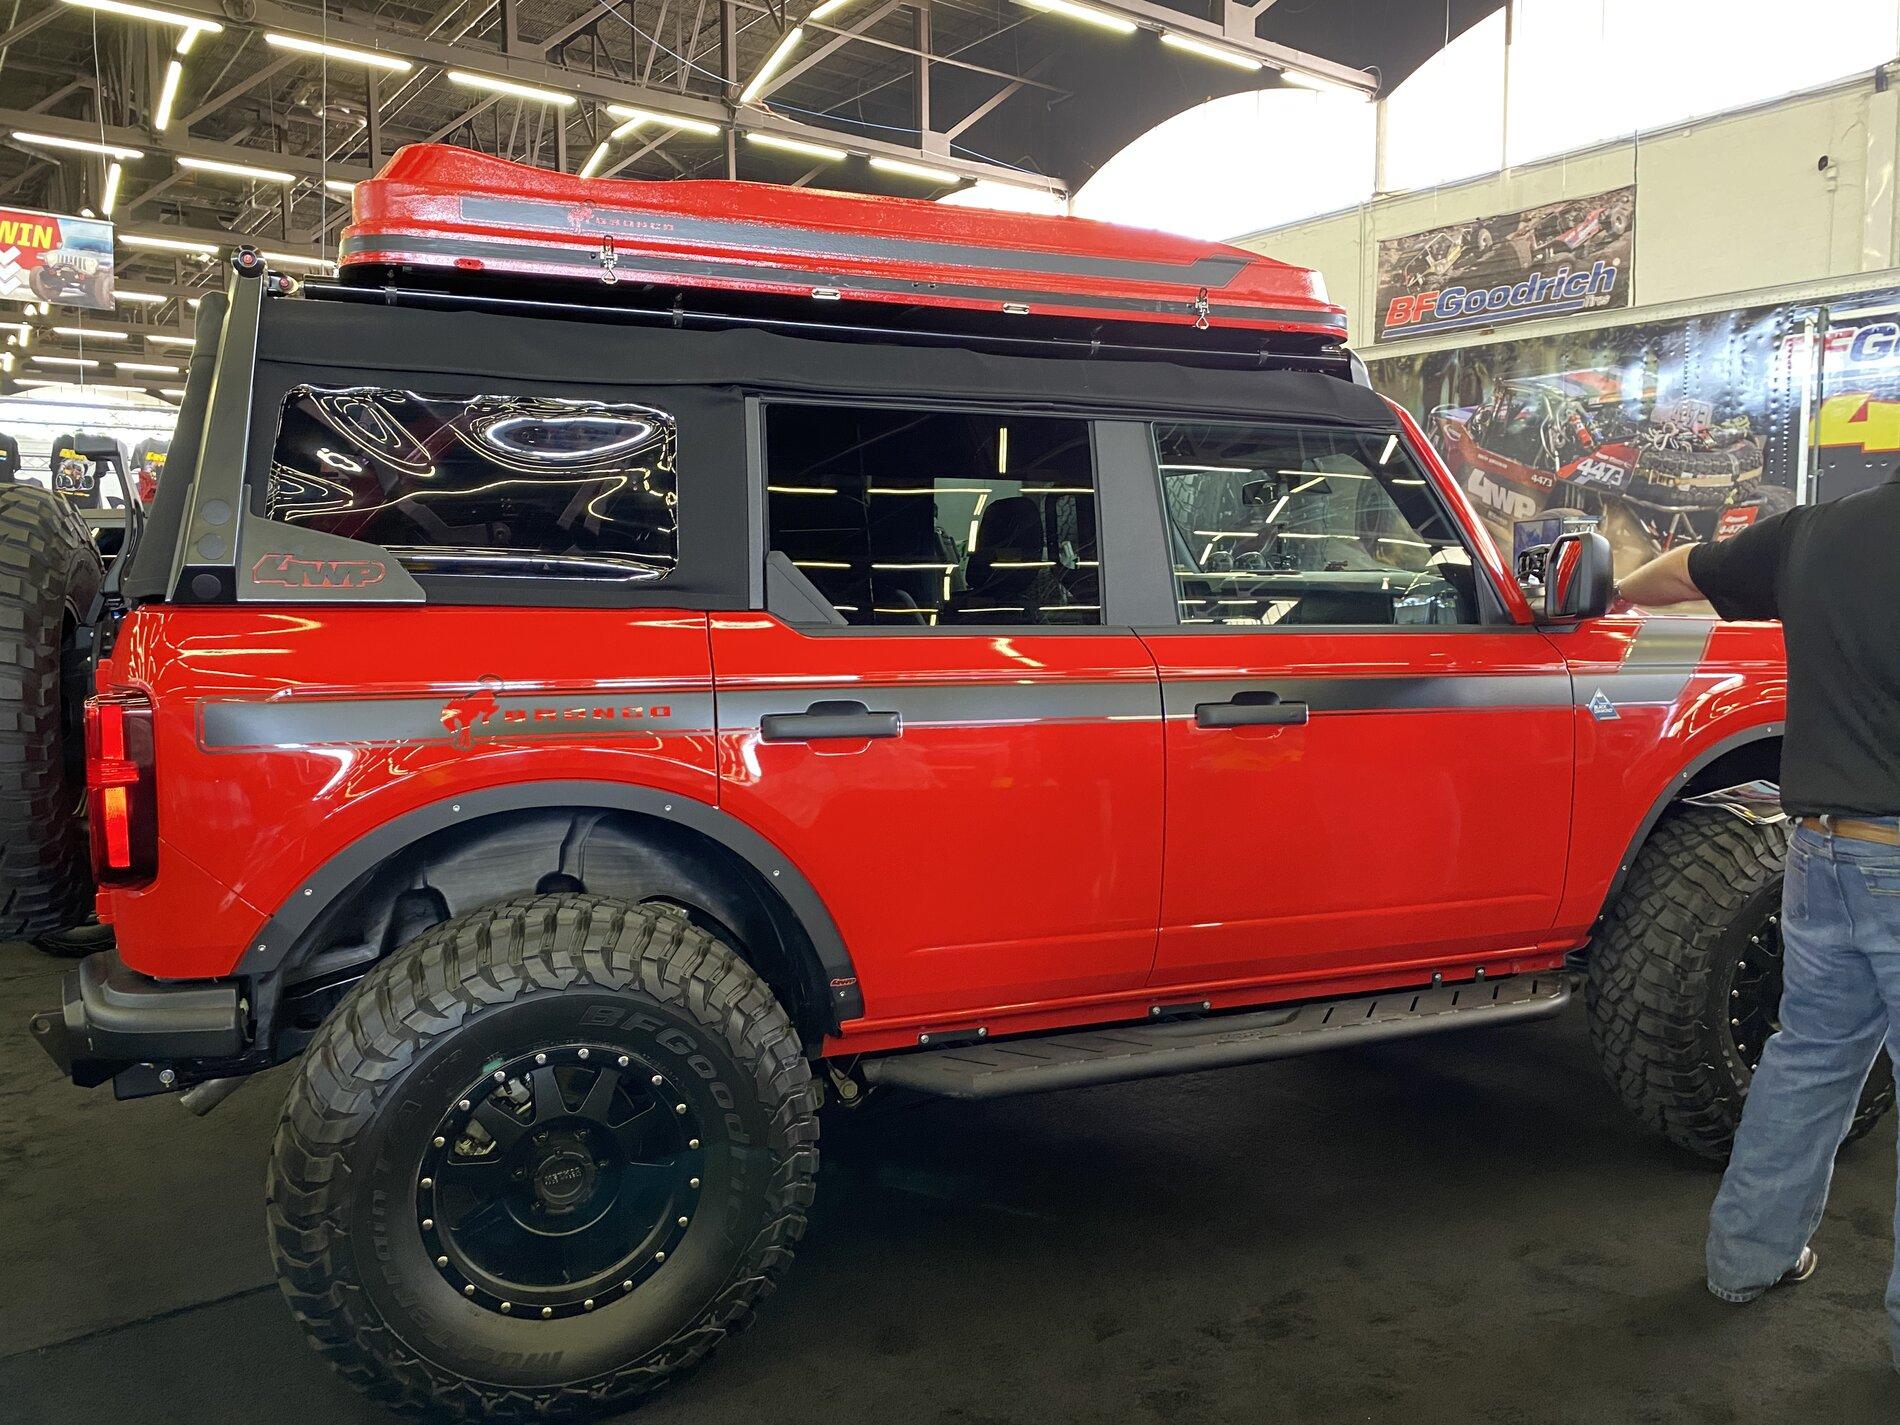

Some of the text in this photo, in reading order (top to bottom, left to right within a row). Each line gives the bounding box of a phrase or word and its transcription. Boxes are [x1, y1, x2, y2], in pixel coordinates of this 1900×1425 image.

[0, 220, 53, 249] WIN
[1385, 260, 1618, 328] BFGoodrich
[1577, 458, 1625, 487] 4473
